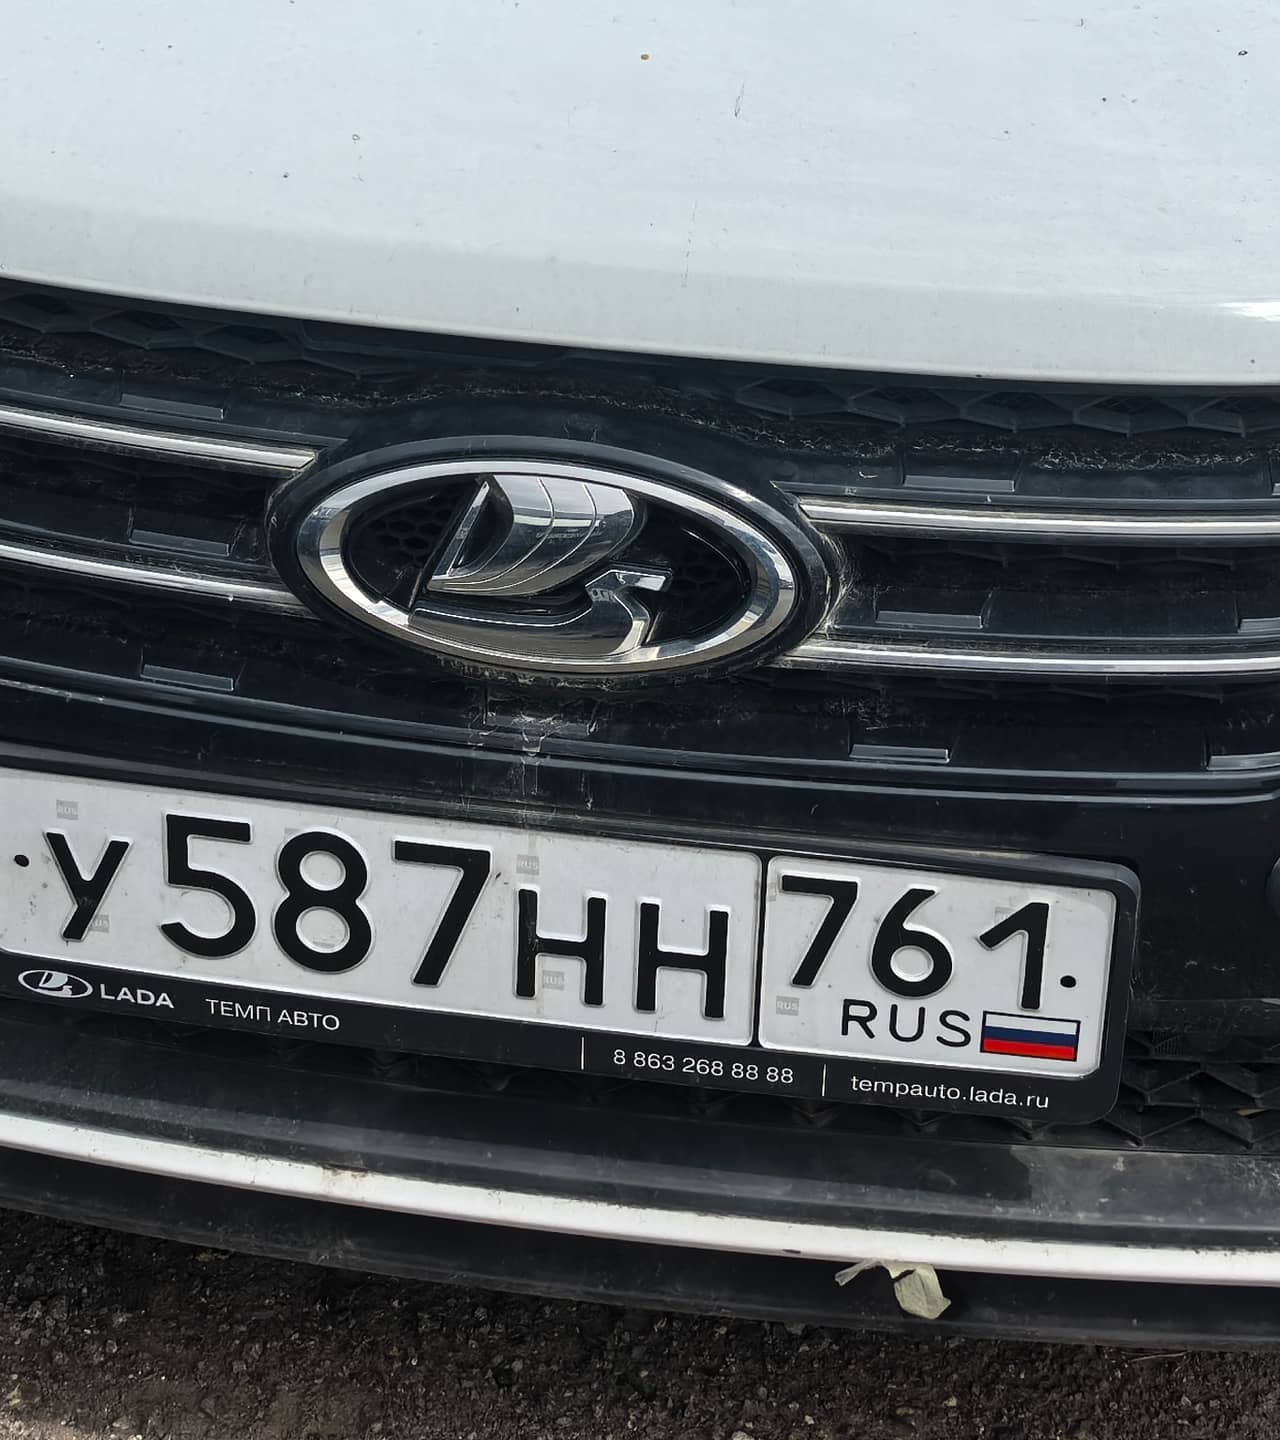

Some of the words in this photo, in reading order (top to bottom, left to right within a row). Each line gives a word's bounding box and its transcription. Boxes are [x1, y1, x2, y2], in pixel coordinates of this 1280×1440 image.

[781, 874, 1050, 1011] 761
[100, 983, 175, 1009] LADA
[205, 998, 271, 1022] ТЕМП
[277, 1009, 340, 1031] АВТО
[841, 998, 972, 1048] RUS
[613, 1049, 626, 1065] 8
[633, 1051, 675, 1071] 863
[682, 1057, 724, 1077] 268
[731, 1062, 759, 1081] 88
[766, 1066, 794, 1084] 88
[850, 1075, 1049, 1109] tempauto.lada.ru
